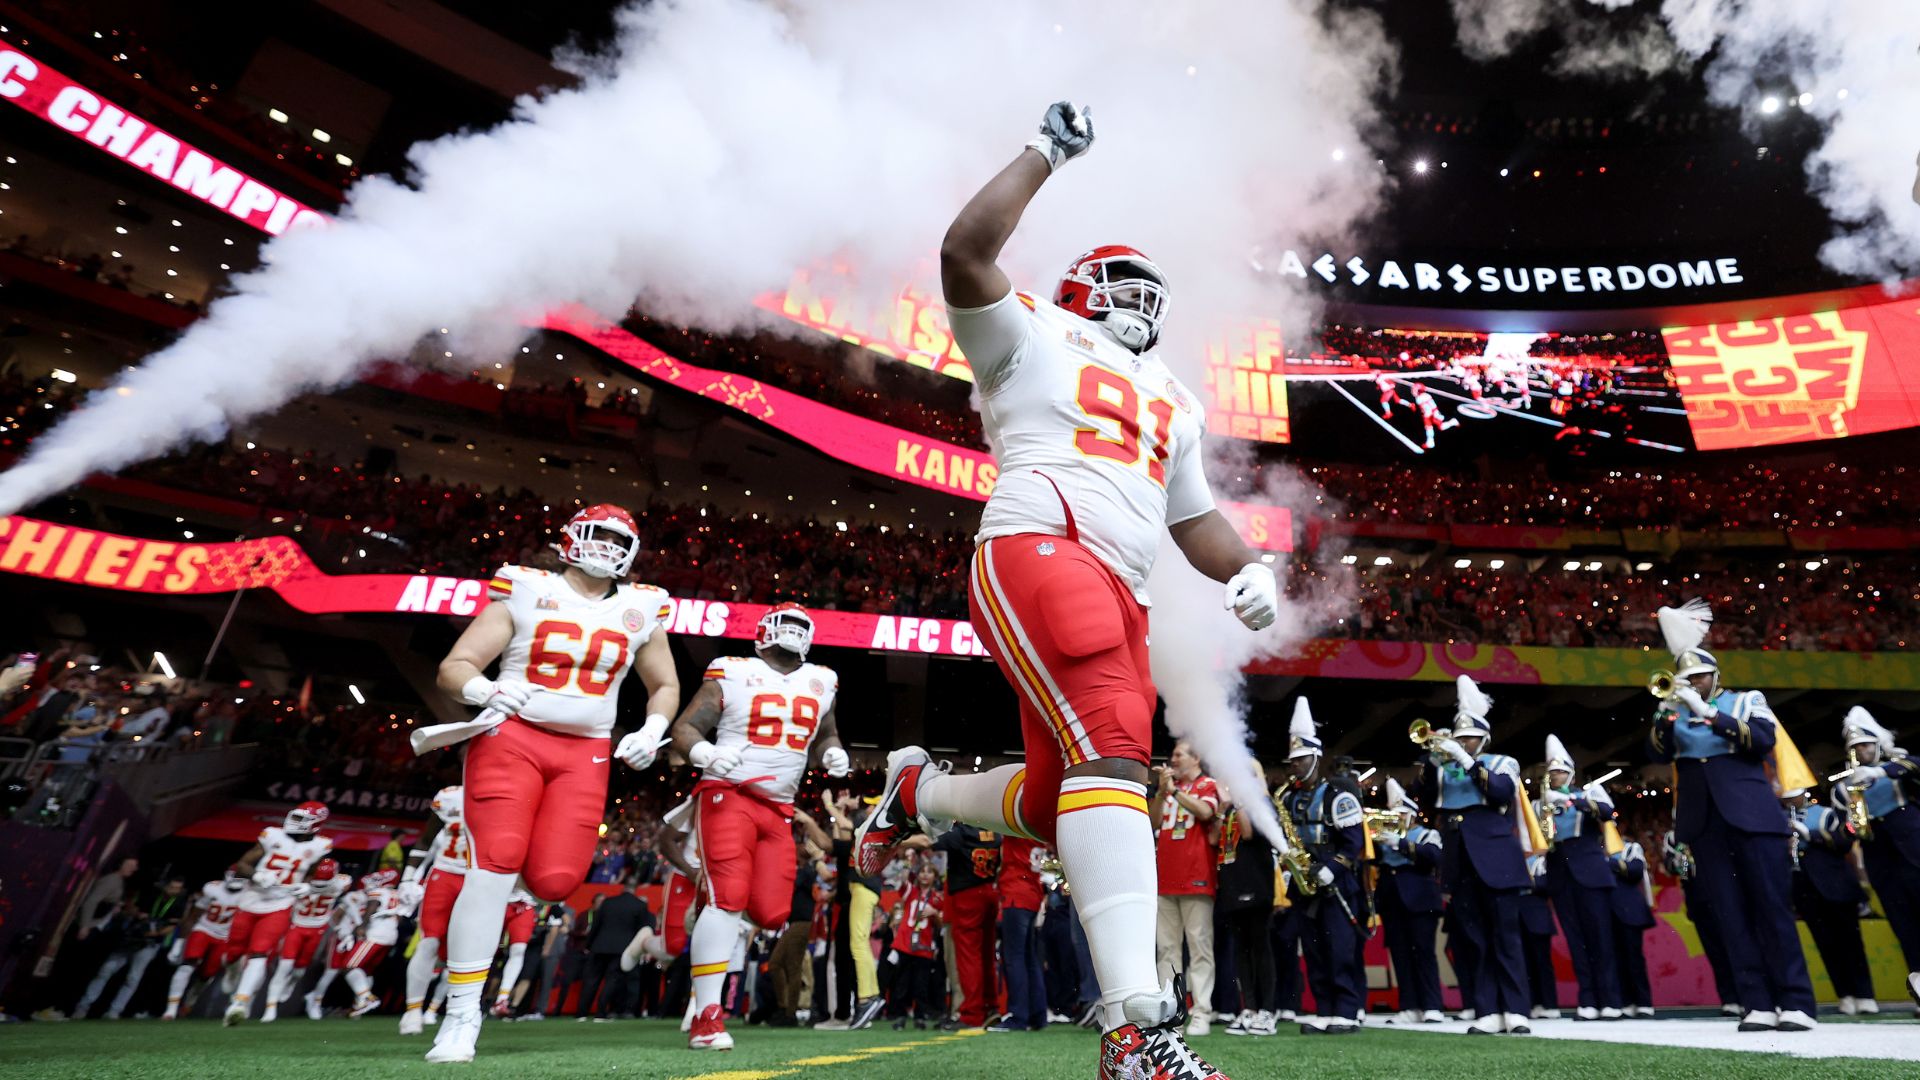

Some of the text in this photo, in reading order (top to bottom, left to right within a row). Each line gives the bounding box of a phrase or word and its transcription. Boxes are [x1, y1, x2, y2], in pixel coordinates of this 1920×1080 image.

[1477, 258, 1744, 293] SUPERDOME
[1074, 363, 1175, 489] 91
[895, 439, 998, 496] KANS
[395, 576, 481, 616] AFC
[526, 619, 629, 696] 60
[871, 615, 941, 653] AFC
[746, 693, 820, 752] 69
[265, 853, 302, 885] 51
